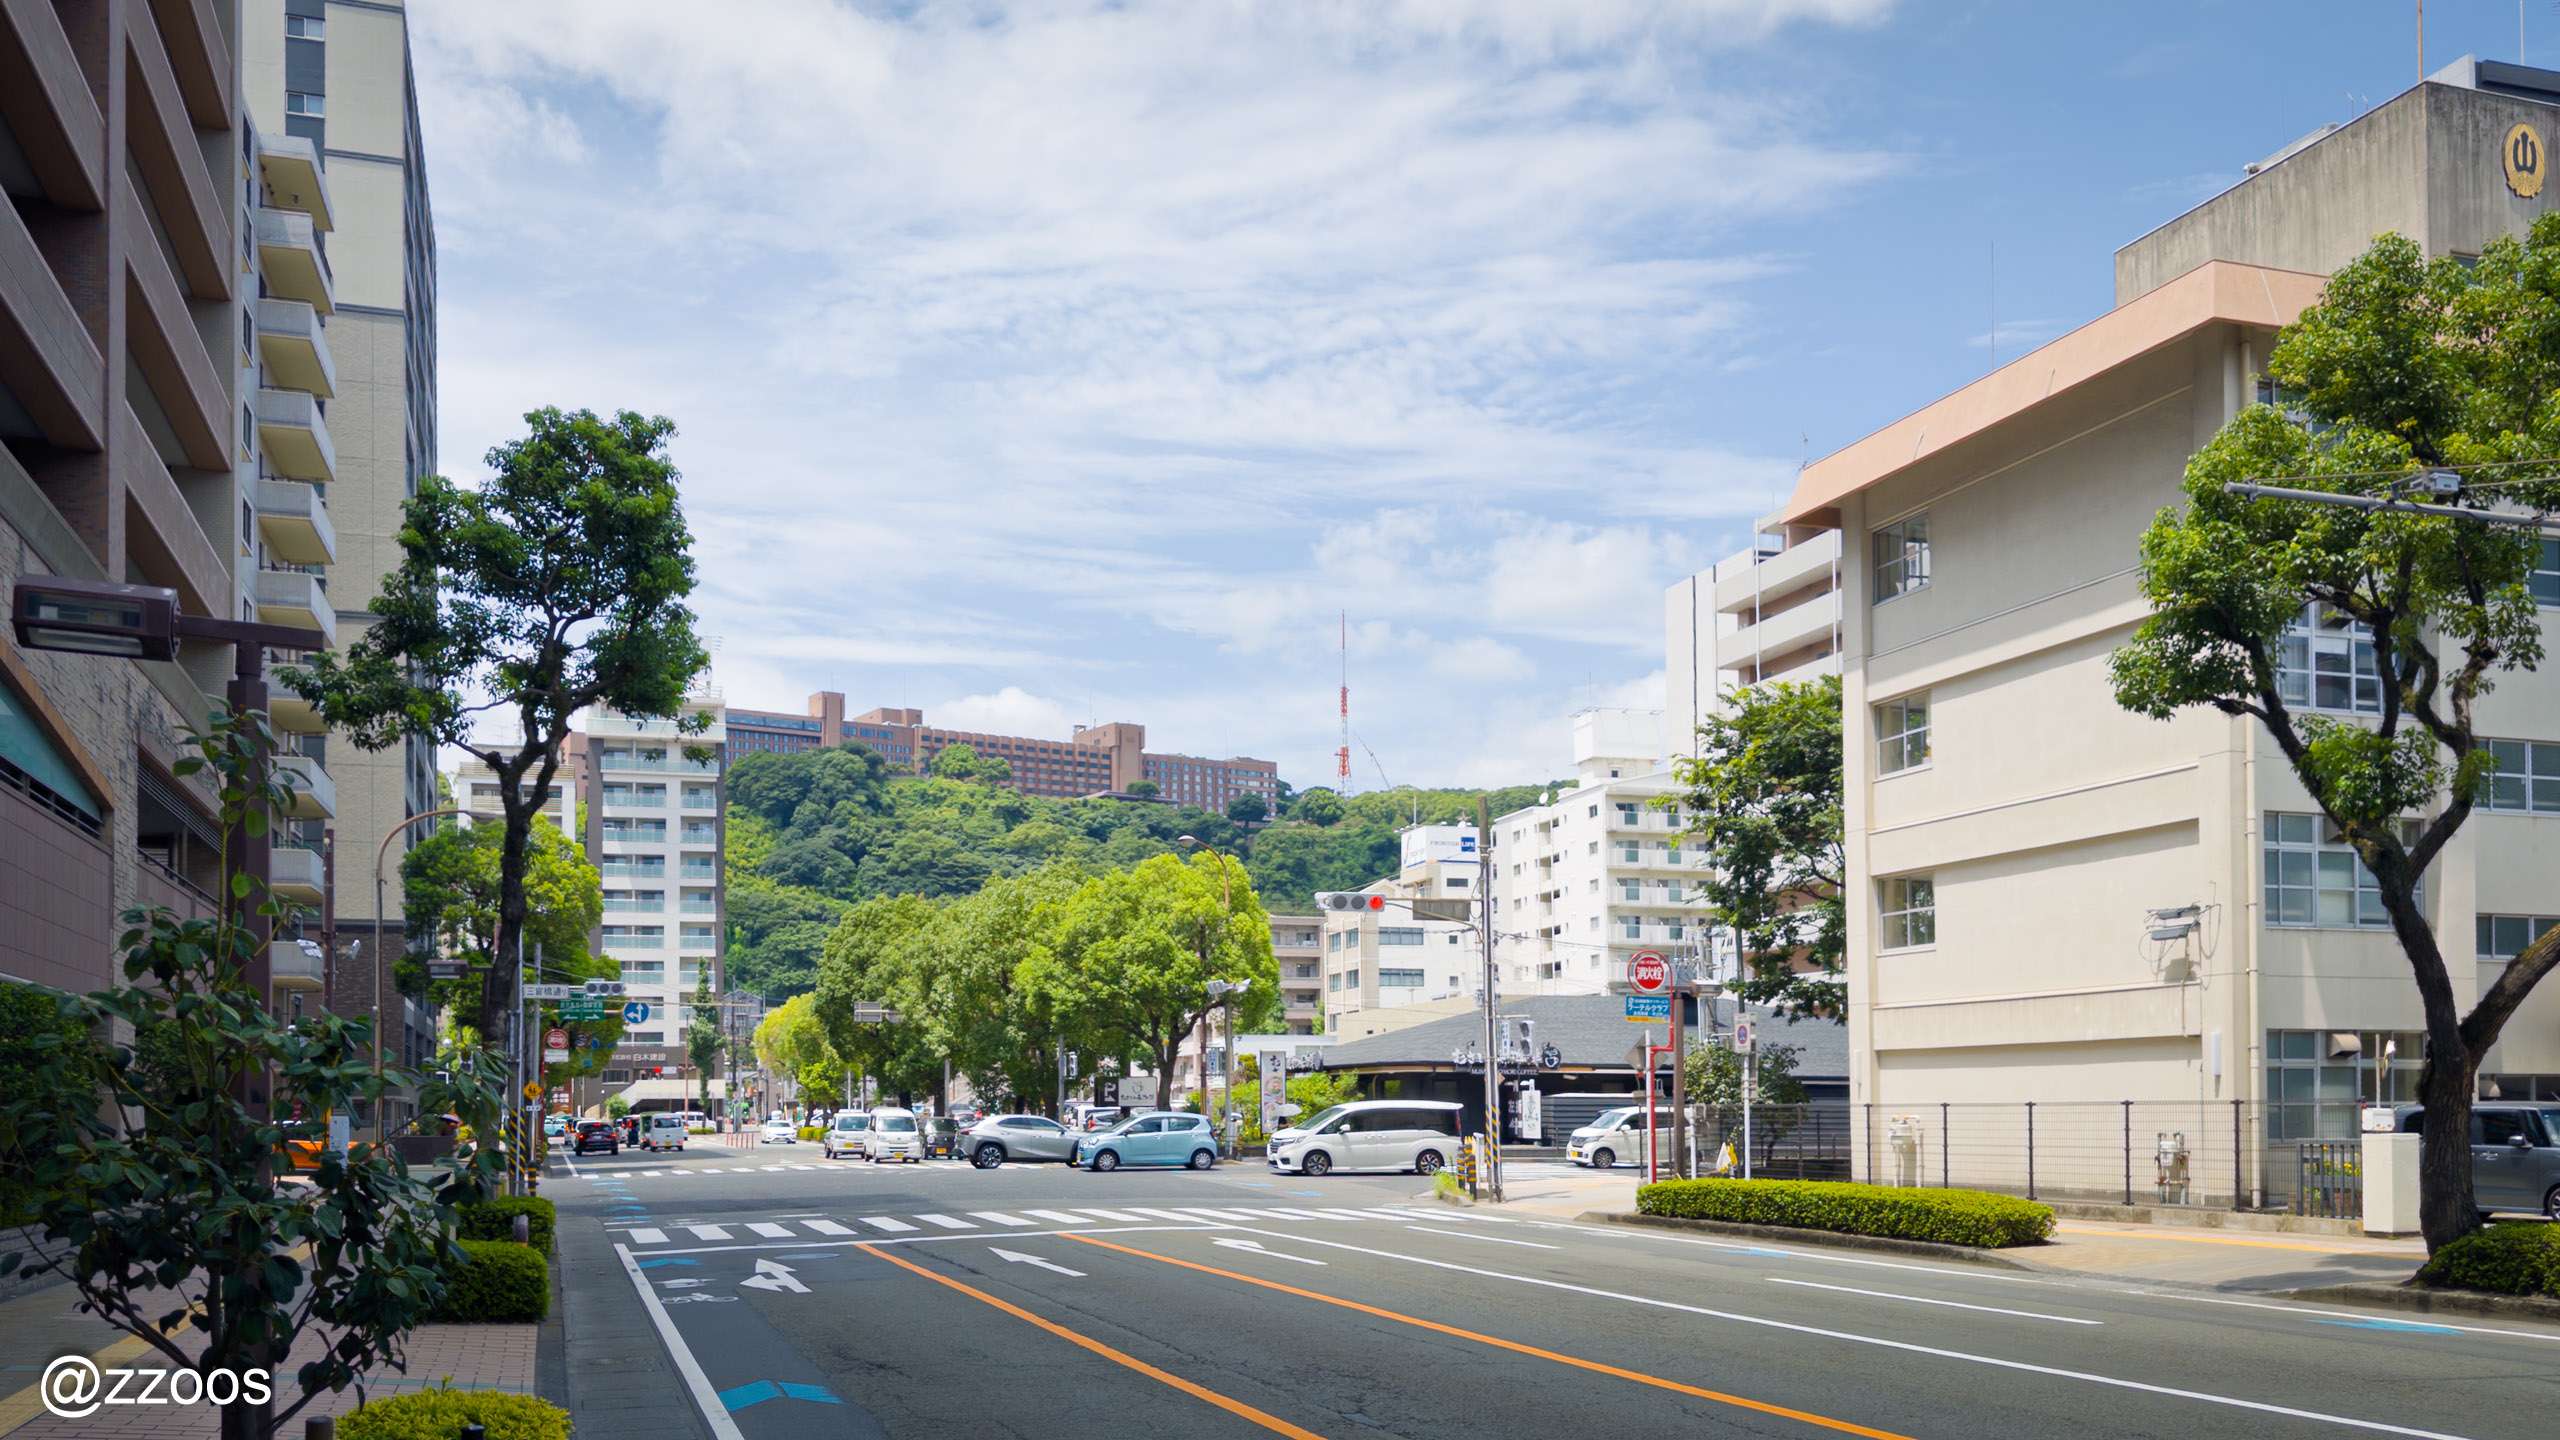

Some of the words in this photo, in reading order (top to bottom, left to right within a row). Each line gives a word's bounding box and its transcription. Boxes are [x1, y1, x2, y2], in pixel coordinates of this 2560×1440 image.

[1637, 966, 1663, 980] 消火栓
[633, 1053, 666, 1061] 白木建設
